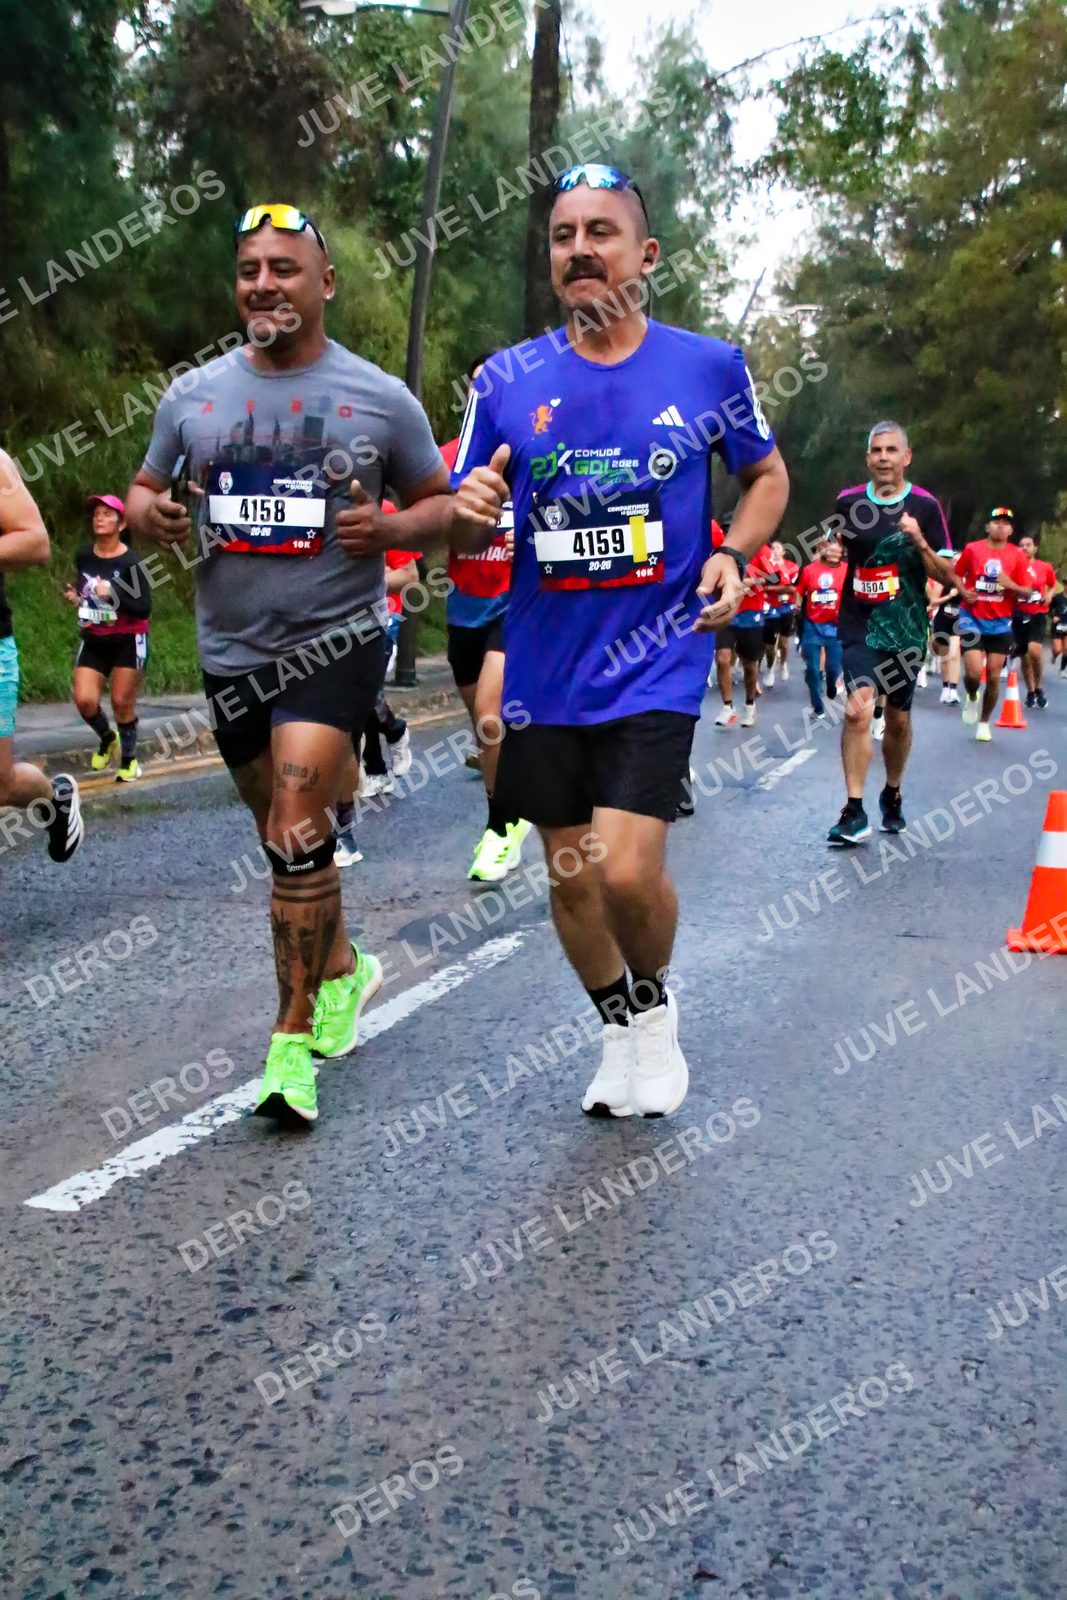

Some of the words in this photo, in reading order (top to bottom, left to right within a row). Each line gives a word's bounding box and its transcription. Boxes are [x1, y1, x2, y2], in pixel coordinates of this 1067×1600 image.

[574, 448, 622, 458] COMUDE
[239, 498, 286, 523] 4158
[292, 540, 311, 549] 10K
[573, 528, 625, 557] 4159
[635, 567, 654, 578] 10K
